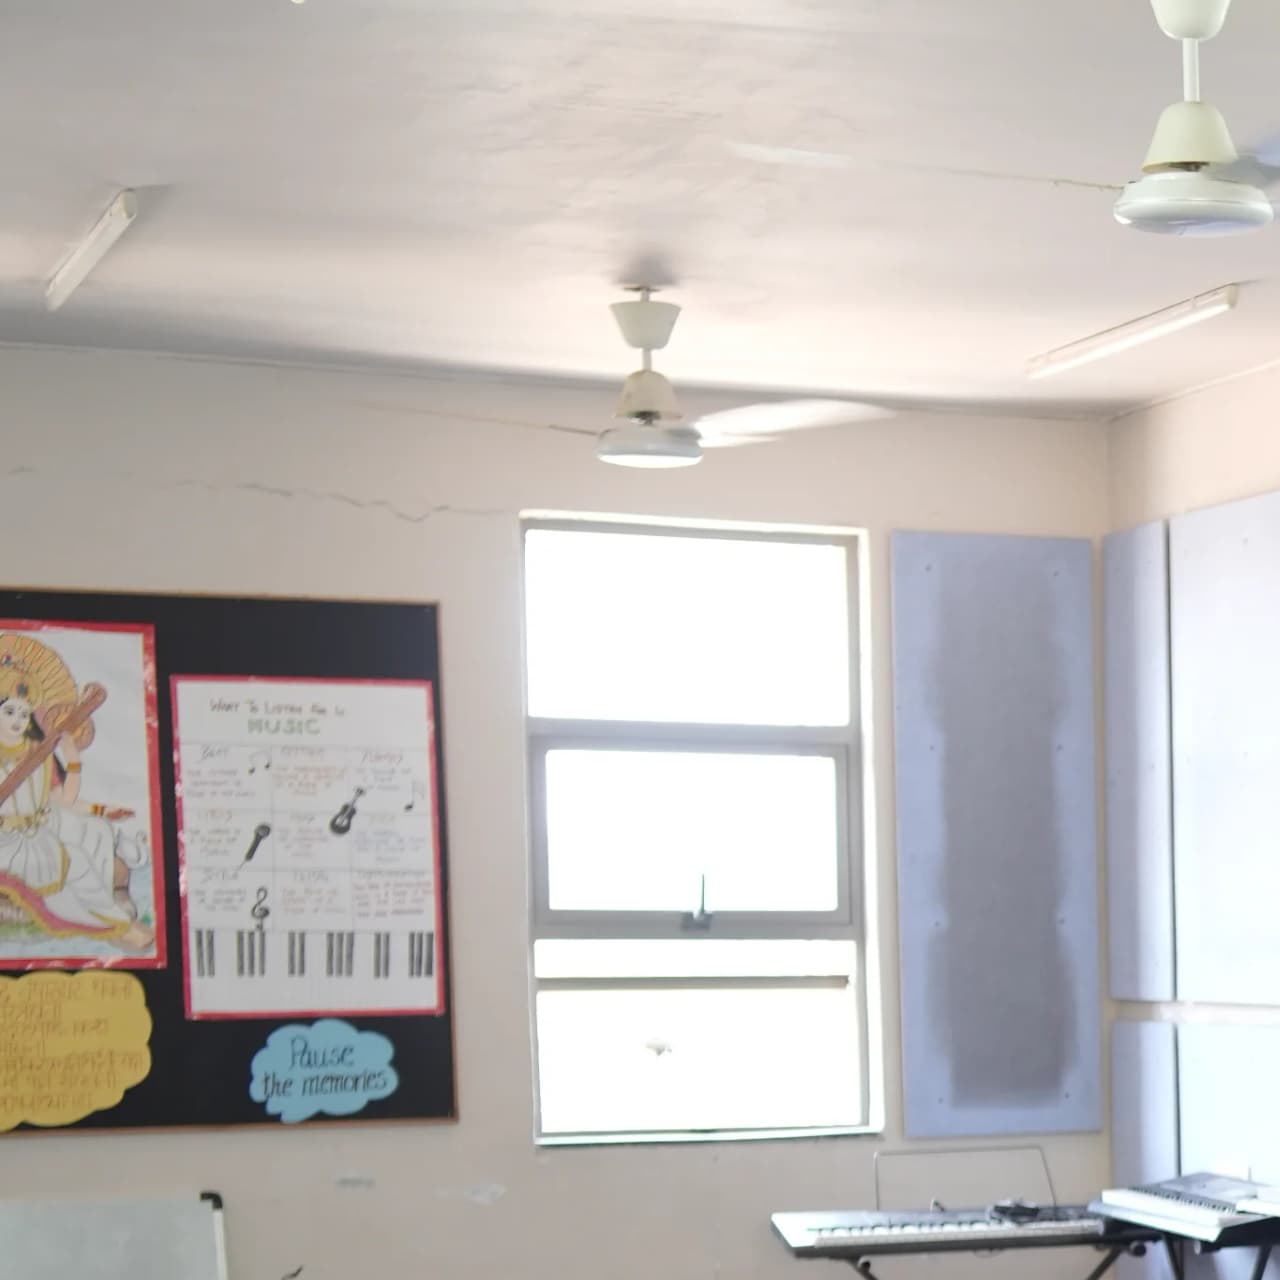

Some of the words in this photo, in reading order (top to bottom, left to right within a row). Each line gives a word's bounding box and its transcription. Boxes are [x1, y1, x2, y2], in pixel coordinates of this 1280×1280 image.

[248, 719, 321, 735] MUSIC
[290, 1036, 355, 1071] Pause
[264, 1071, 293, 1097] the
[302, 1068, 388, 1096] memories
